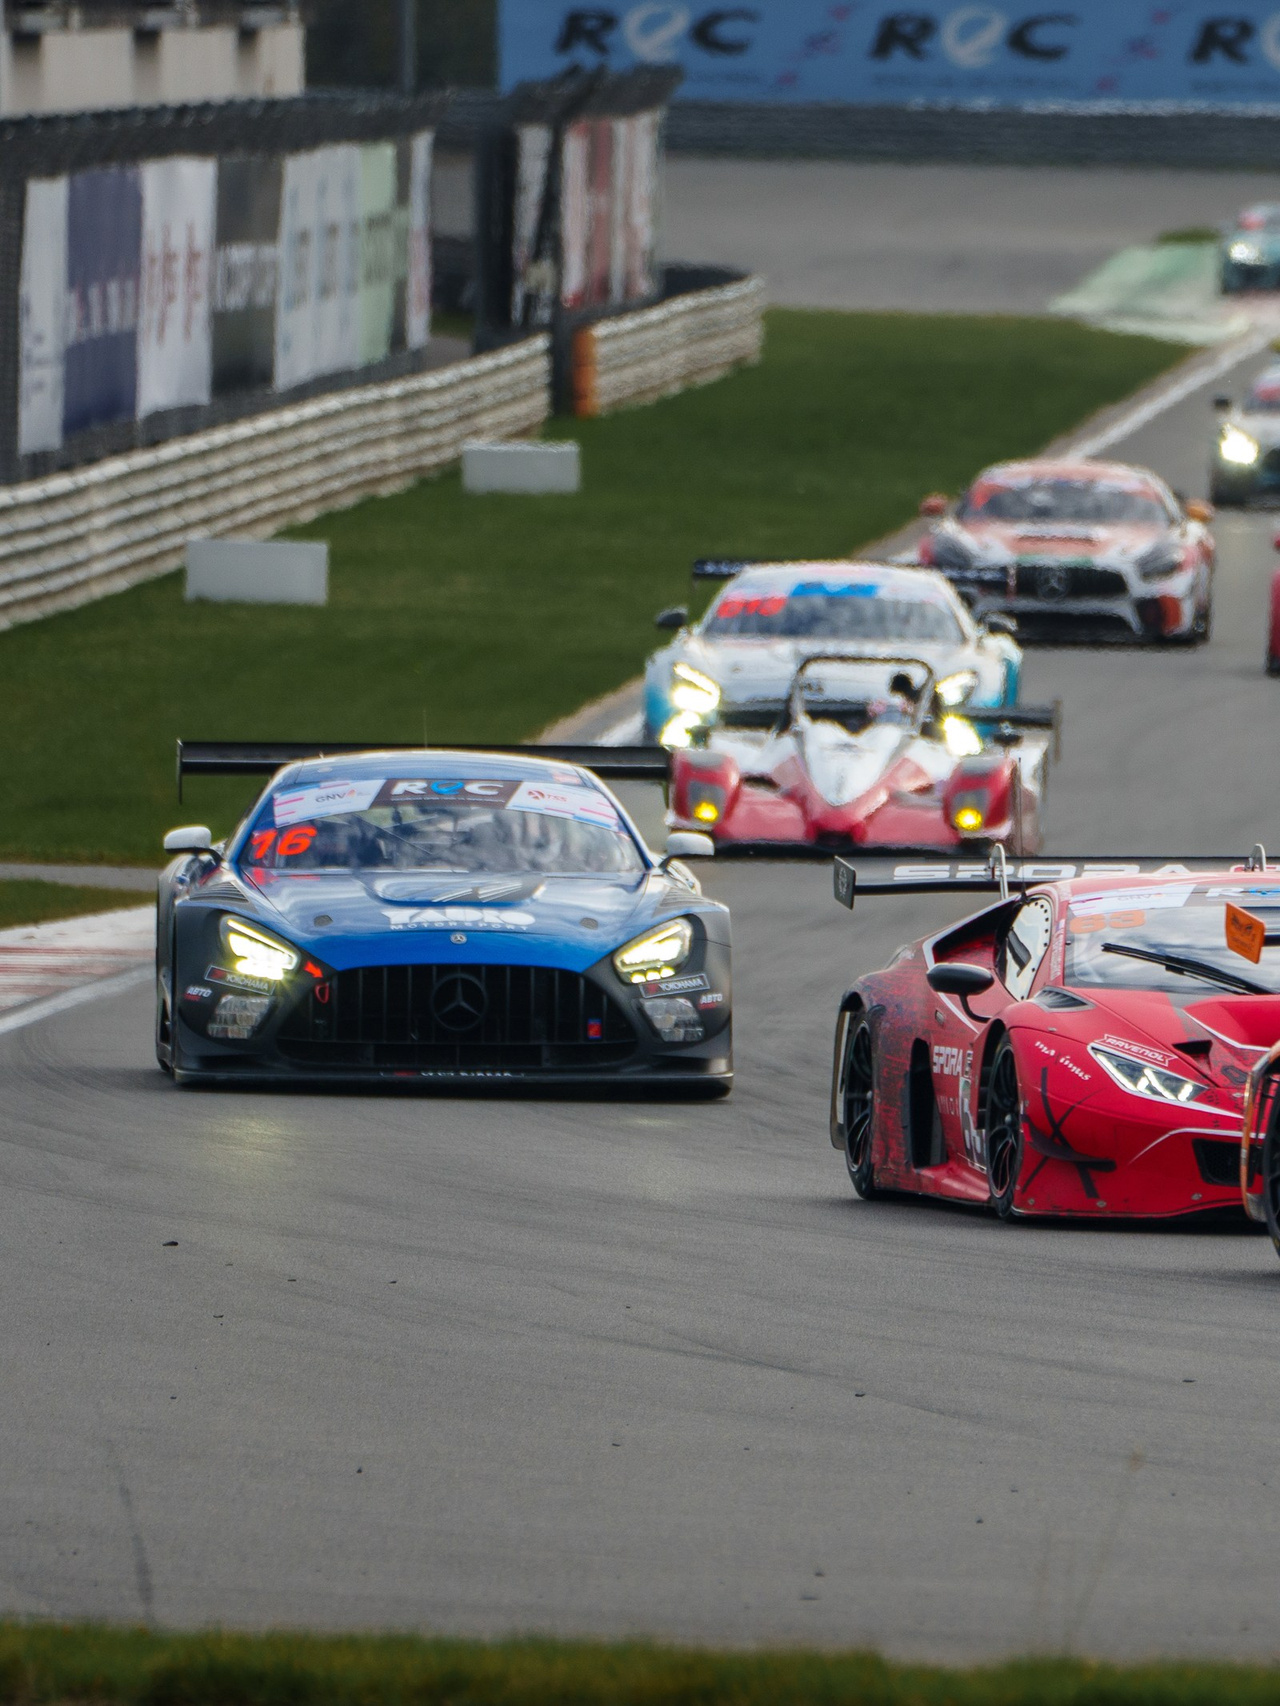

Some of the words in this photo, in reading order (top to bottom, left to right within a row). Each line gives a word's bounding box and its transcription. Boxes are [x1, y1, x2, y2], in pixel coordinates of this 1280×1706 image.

[251, 825, 317, 860] 16
[381, 909, 535, 925] YADRO
[389, 921, 528, 931] MOTORSPORT
[225, 974, 269, 991] YOKOHAMA
[658, 978, 704, 992] YOKOHAMA
[1105, 1037, 1167, 1062] RAVENOL
[932, 1045, 964, 1077] SPORA
